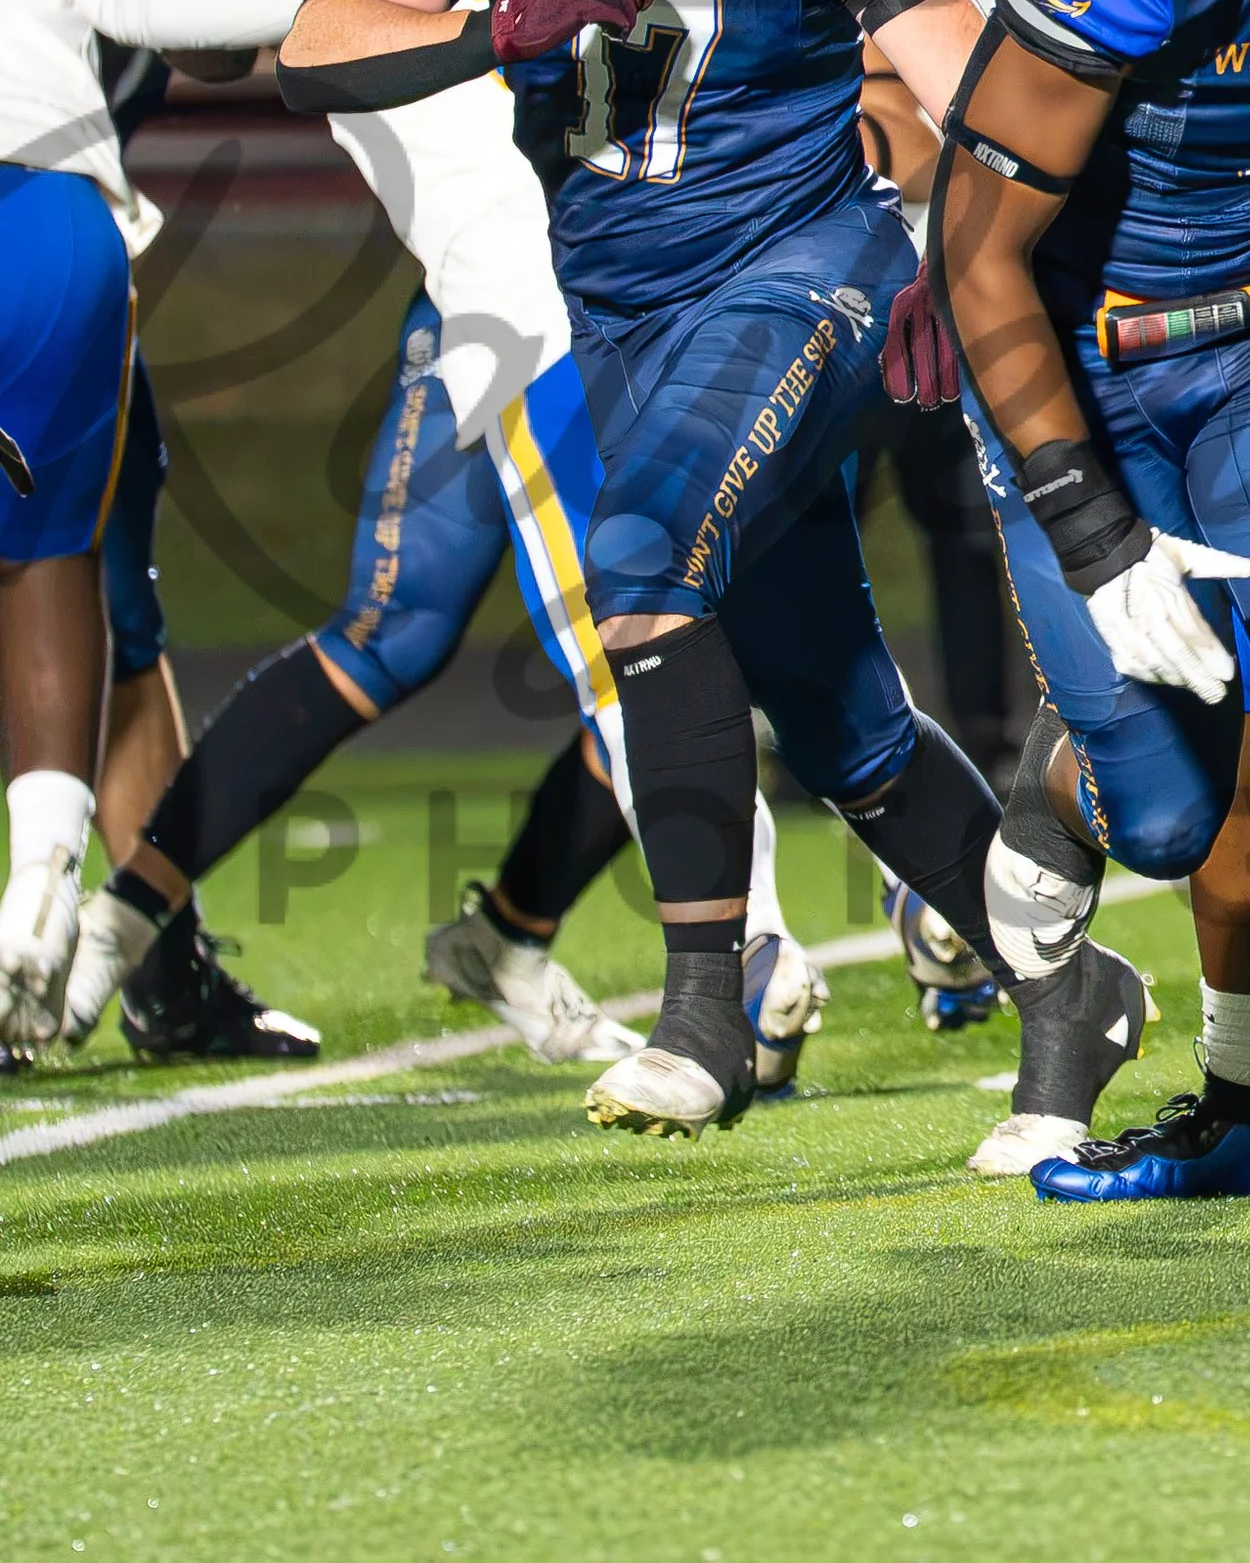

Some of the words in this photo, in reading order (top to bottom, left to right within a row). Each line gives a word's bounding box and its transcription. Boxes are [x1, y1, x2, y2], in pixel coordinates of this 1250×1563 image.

[973, 141, 1020, 178] NXTRND
[713, 445, 758, 518] GIVE
[747, 407, 781, 455] UP
[769, 357, 814, 417] THE
